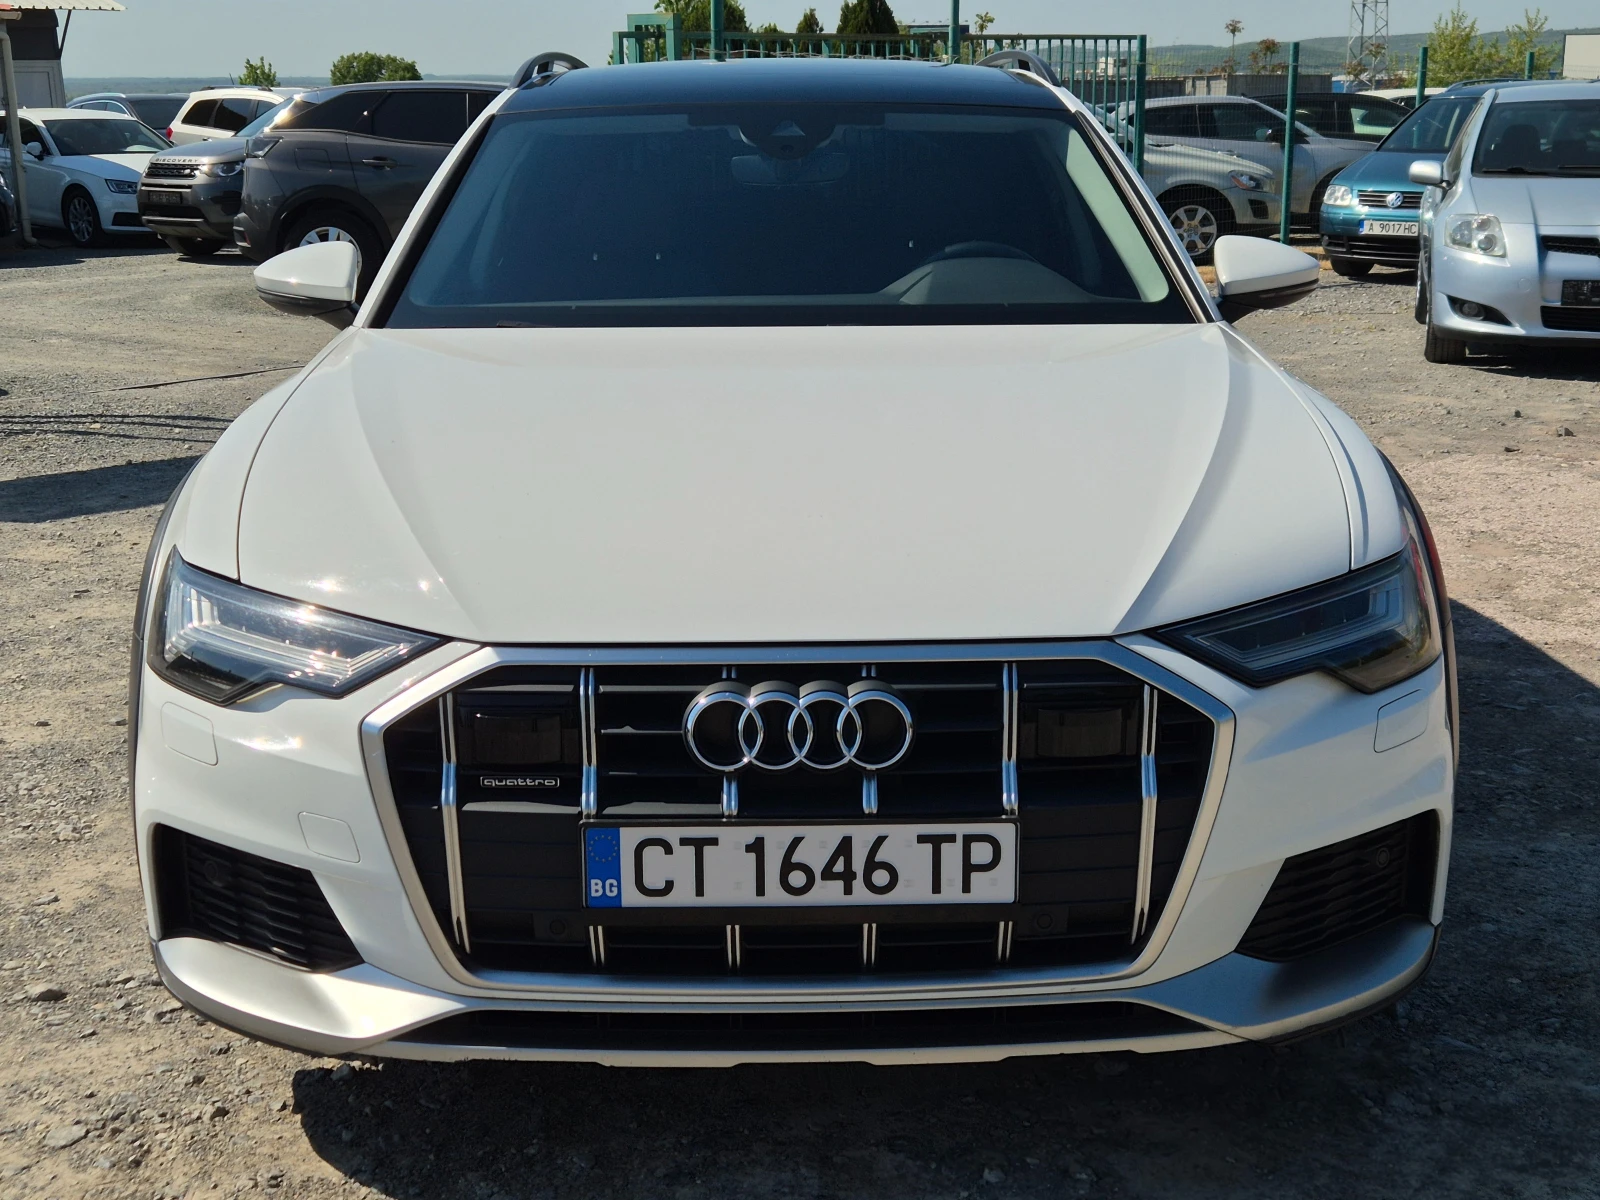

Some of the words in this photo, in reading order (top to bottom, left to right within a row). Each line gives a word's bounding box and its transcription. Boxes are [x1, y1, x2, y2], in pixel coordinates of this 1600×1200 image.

[1368, 222, 1375, 232] A
[1379, 222, 1402, 233] 9017
[1403, 223, 1417, 235] HC
[484, 778, 556, 787] quattro
[634, 837, 719, 897] CT
[745, 836, 899, 897] 1646
[917, 834, 1001, 895] TP
[590, 878, 618, 897] BG
